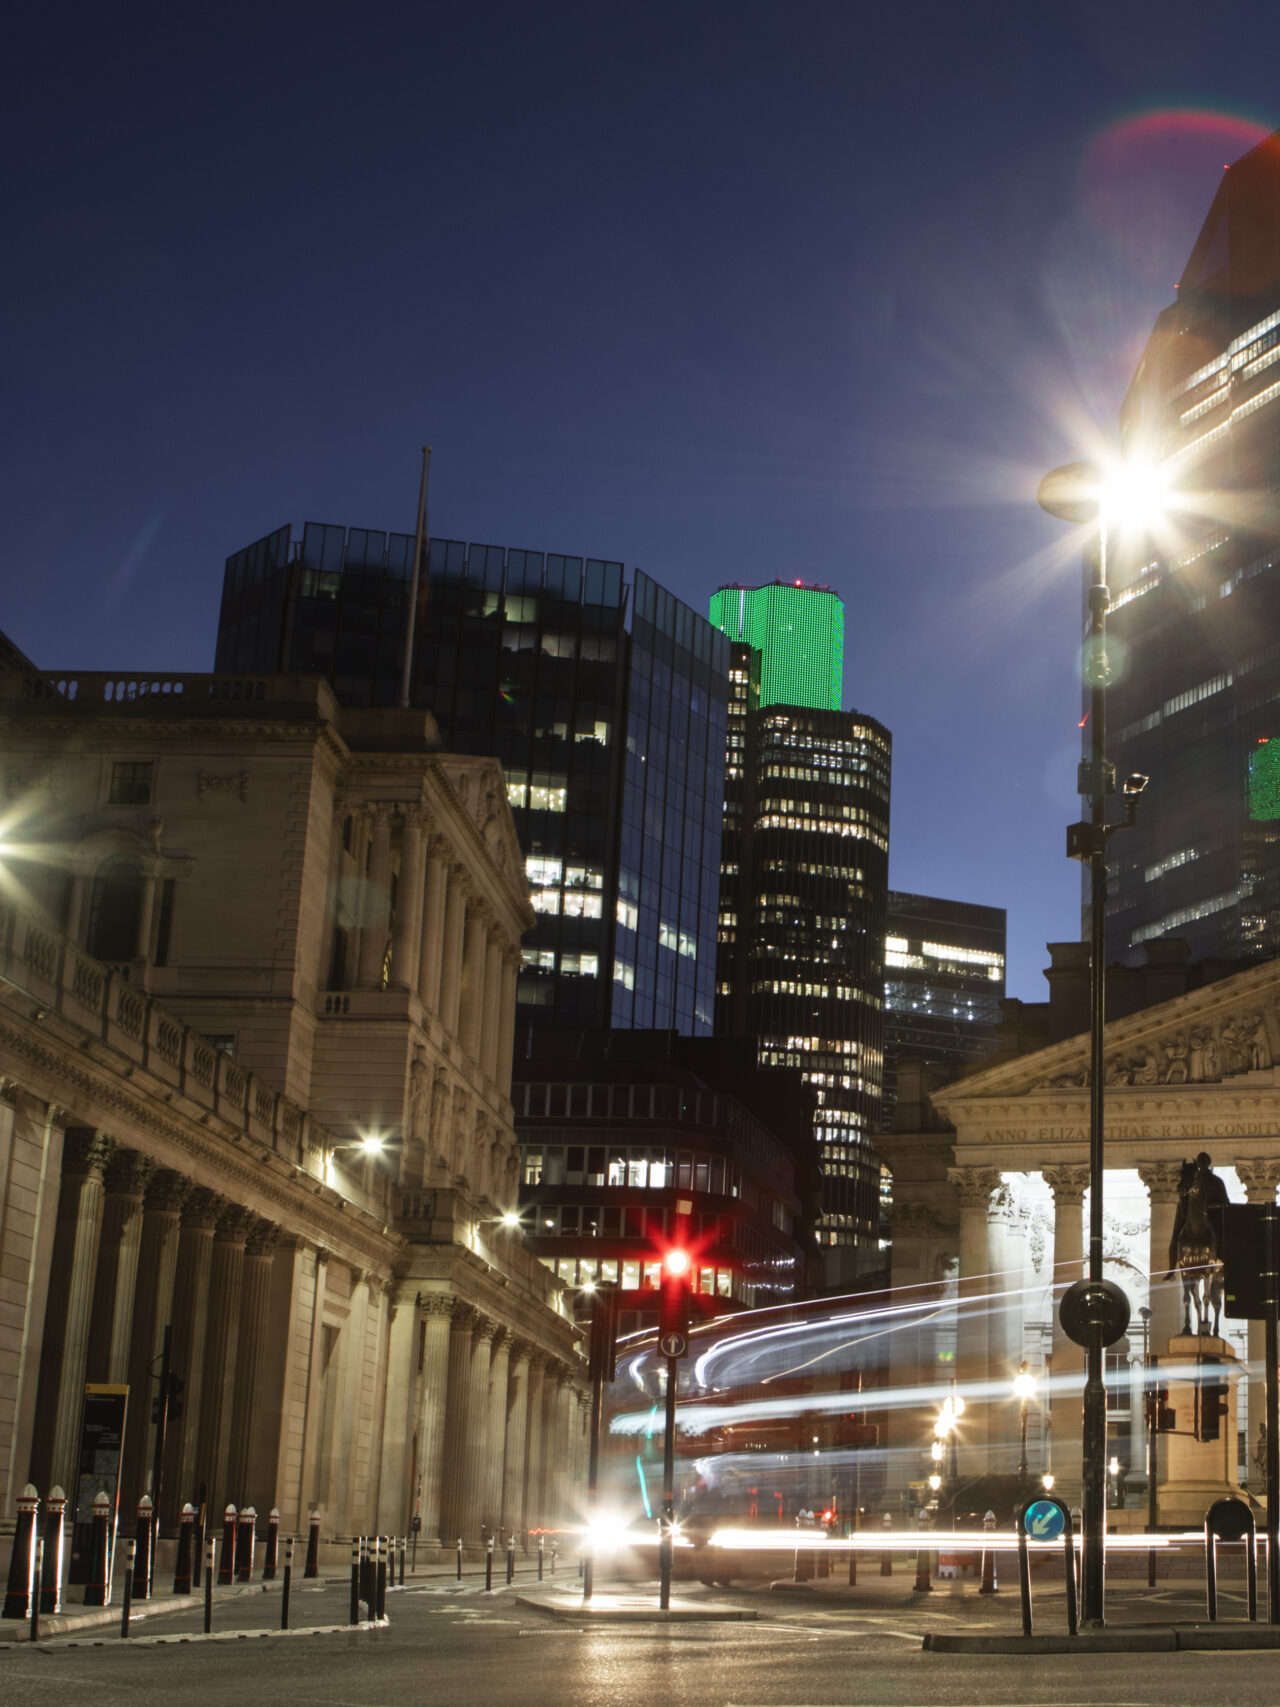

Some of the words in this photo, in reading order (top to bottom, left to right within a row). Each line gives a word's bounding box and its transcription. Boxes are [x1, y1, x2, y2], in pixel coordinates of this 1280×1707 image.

[983, 1129, 1028, 1142] ANNO
[1038, 1125, 1151, 1141] ELIZATHAE
[1161, 1125, 1172, 1137] R
[1180, 1123, 1206, 1137] XIII
